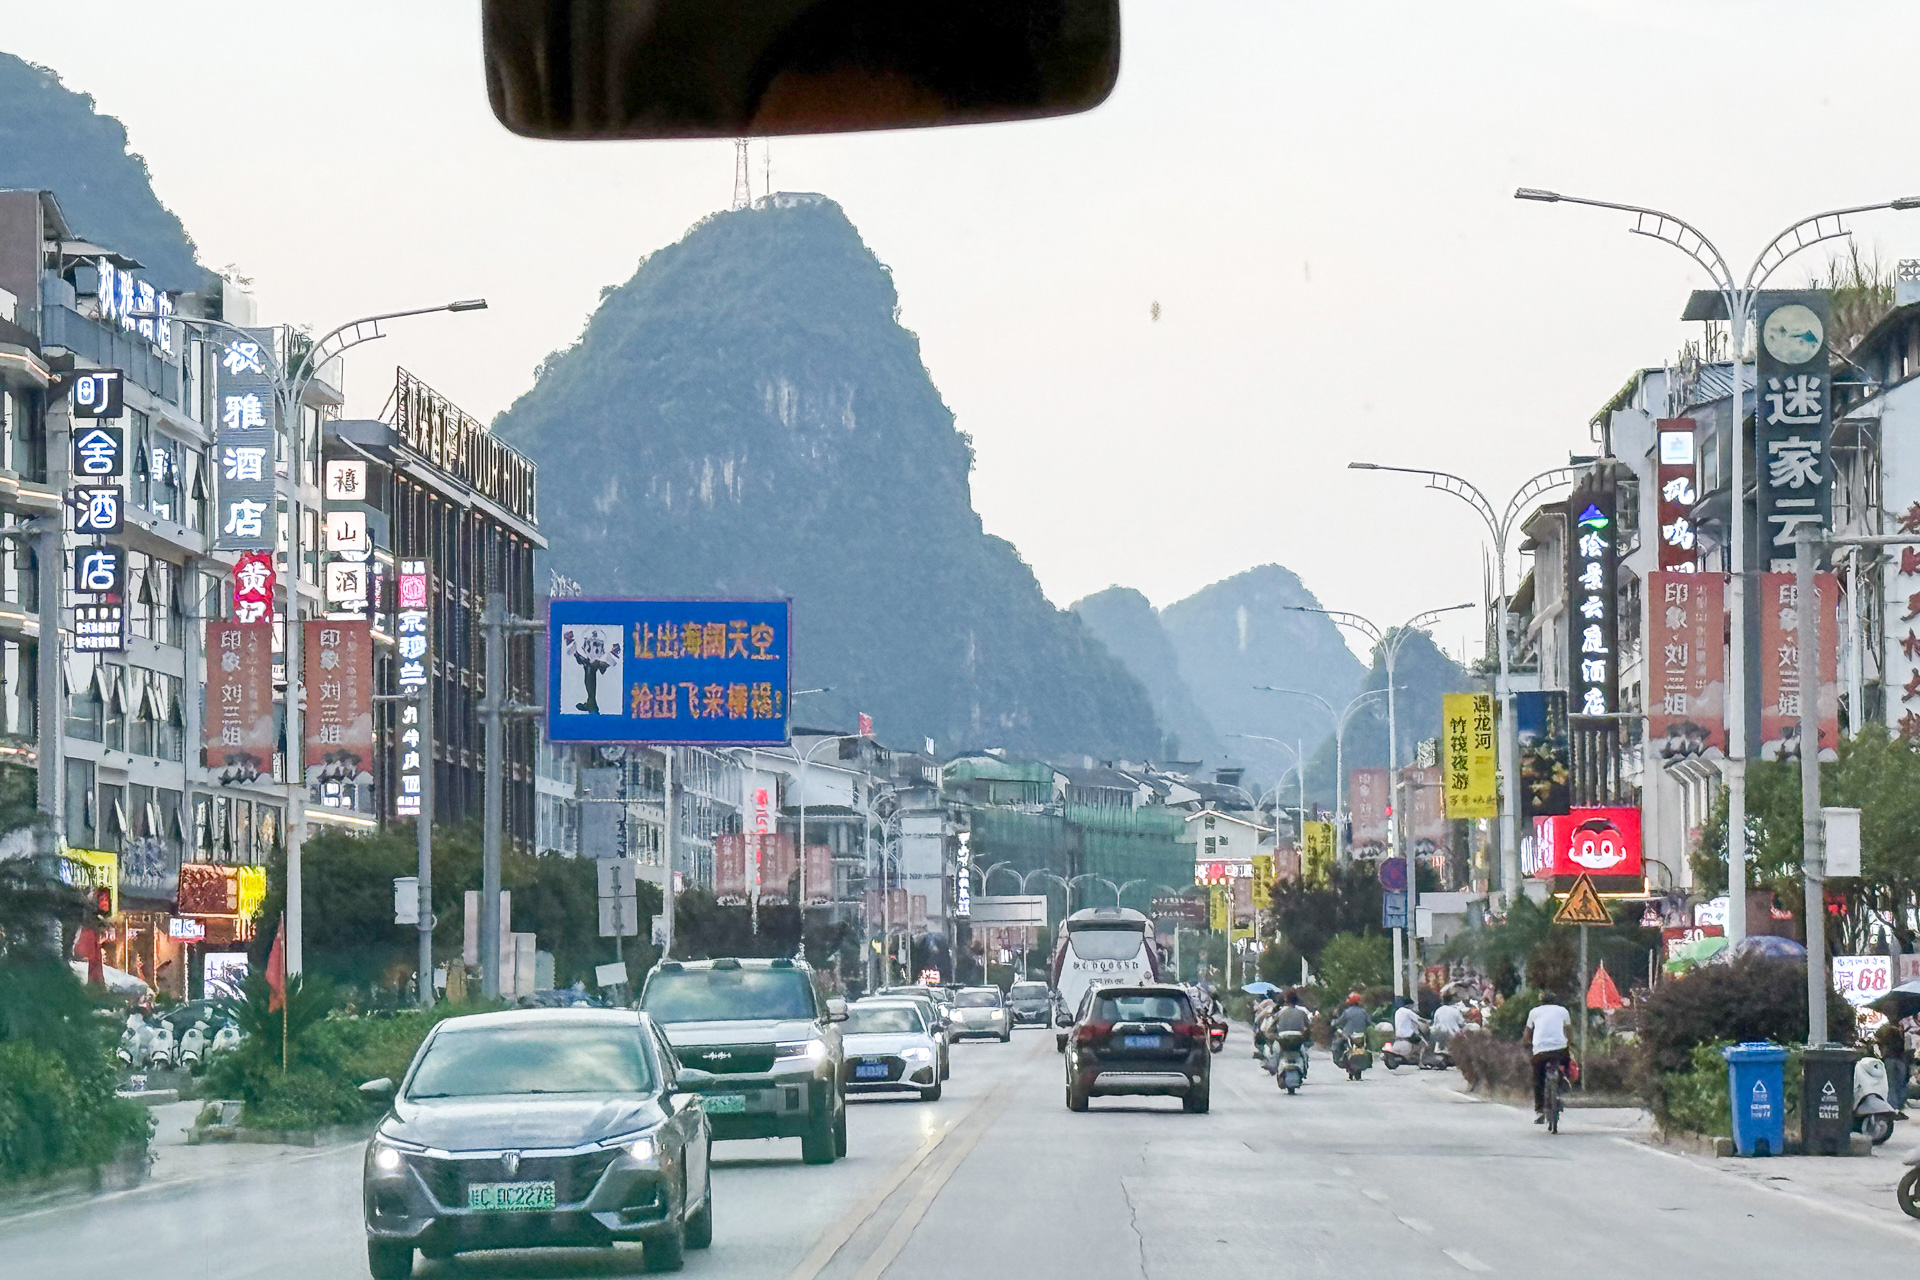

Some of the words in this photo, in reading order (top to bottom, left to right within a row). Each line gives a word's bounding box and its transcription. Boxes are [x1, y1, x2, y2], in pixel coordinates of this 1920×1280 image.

[77, 373, 119, 590] 町舍酒店
[1765, 375, 1823, 574] 迷家云
[632, 620, 780, 660] 让出海阔天空
[1473, 695, 1492, 750] 遇龙河
[1857, 967, 1888, 991] 68
